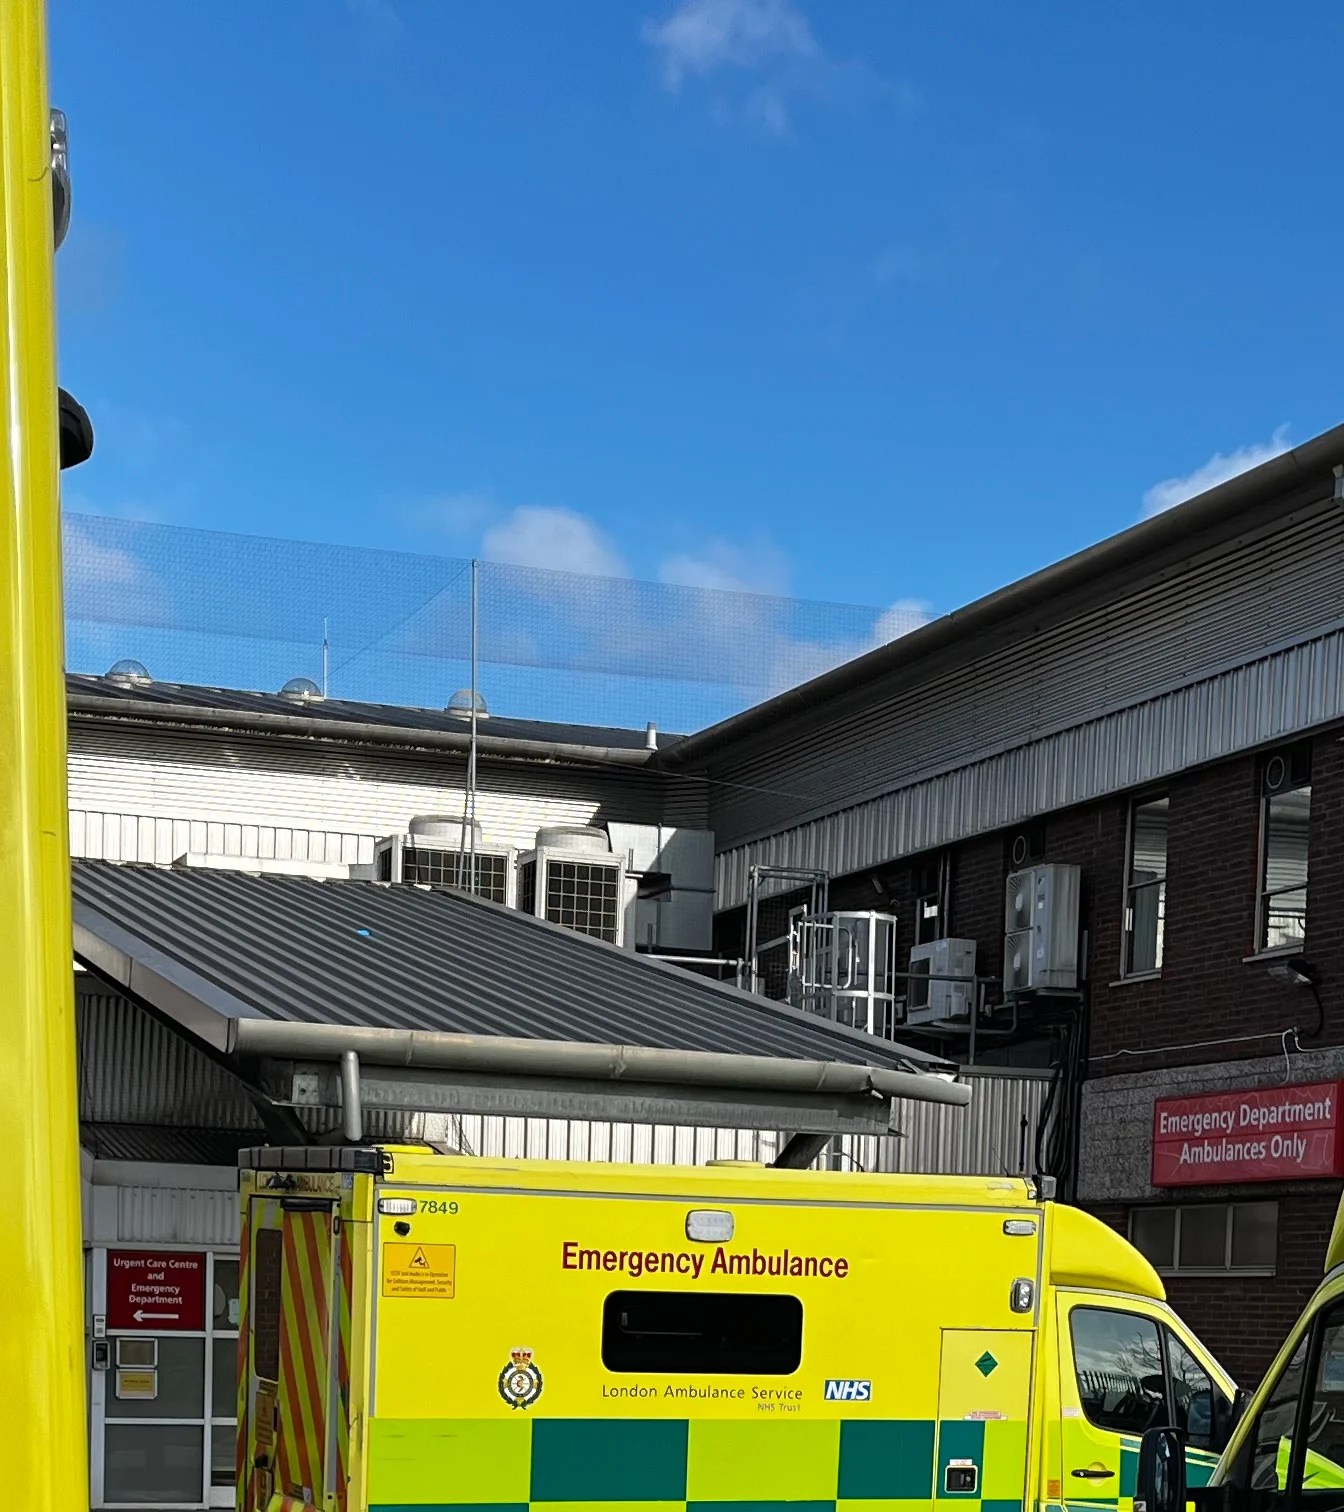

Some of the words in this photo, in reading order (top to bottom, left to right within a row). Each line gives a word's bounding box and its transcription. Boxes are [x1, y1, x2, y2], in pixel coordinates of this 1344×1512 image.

[1159, 1109, 1236, 1137] Emergency
[1239, 1098, 1332, 1131] Department
[1179, 1138, 1267, 1165] Ambulances
[1270, 1133, 1307, 1163] Only
[419, 1200, 459, 1214] 7849
[113, 1258, 145, 1270] Urgent
[146, 1259, 167, 1269] Care
[168, 1259, 199, 1270] Centre
[561, 1241, 705, 1280] Emergency
[710, 1246, 850, 1279] Ambulance
[147, 1271, 165, 1280] and
[131, 1283, 181, 1295] Emergency
[128, 1295, 183, 1306] Department
[602, 1384, 658, 1398] London
[664, 1385, 746, 1400] Ambulance
[751, 1386, 803, 1400] Service
[825, 1381, 870, 1400] NHS
[757, 1403, 775, 1412] NHS
[779, 1403, 801, 1412] Trust
